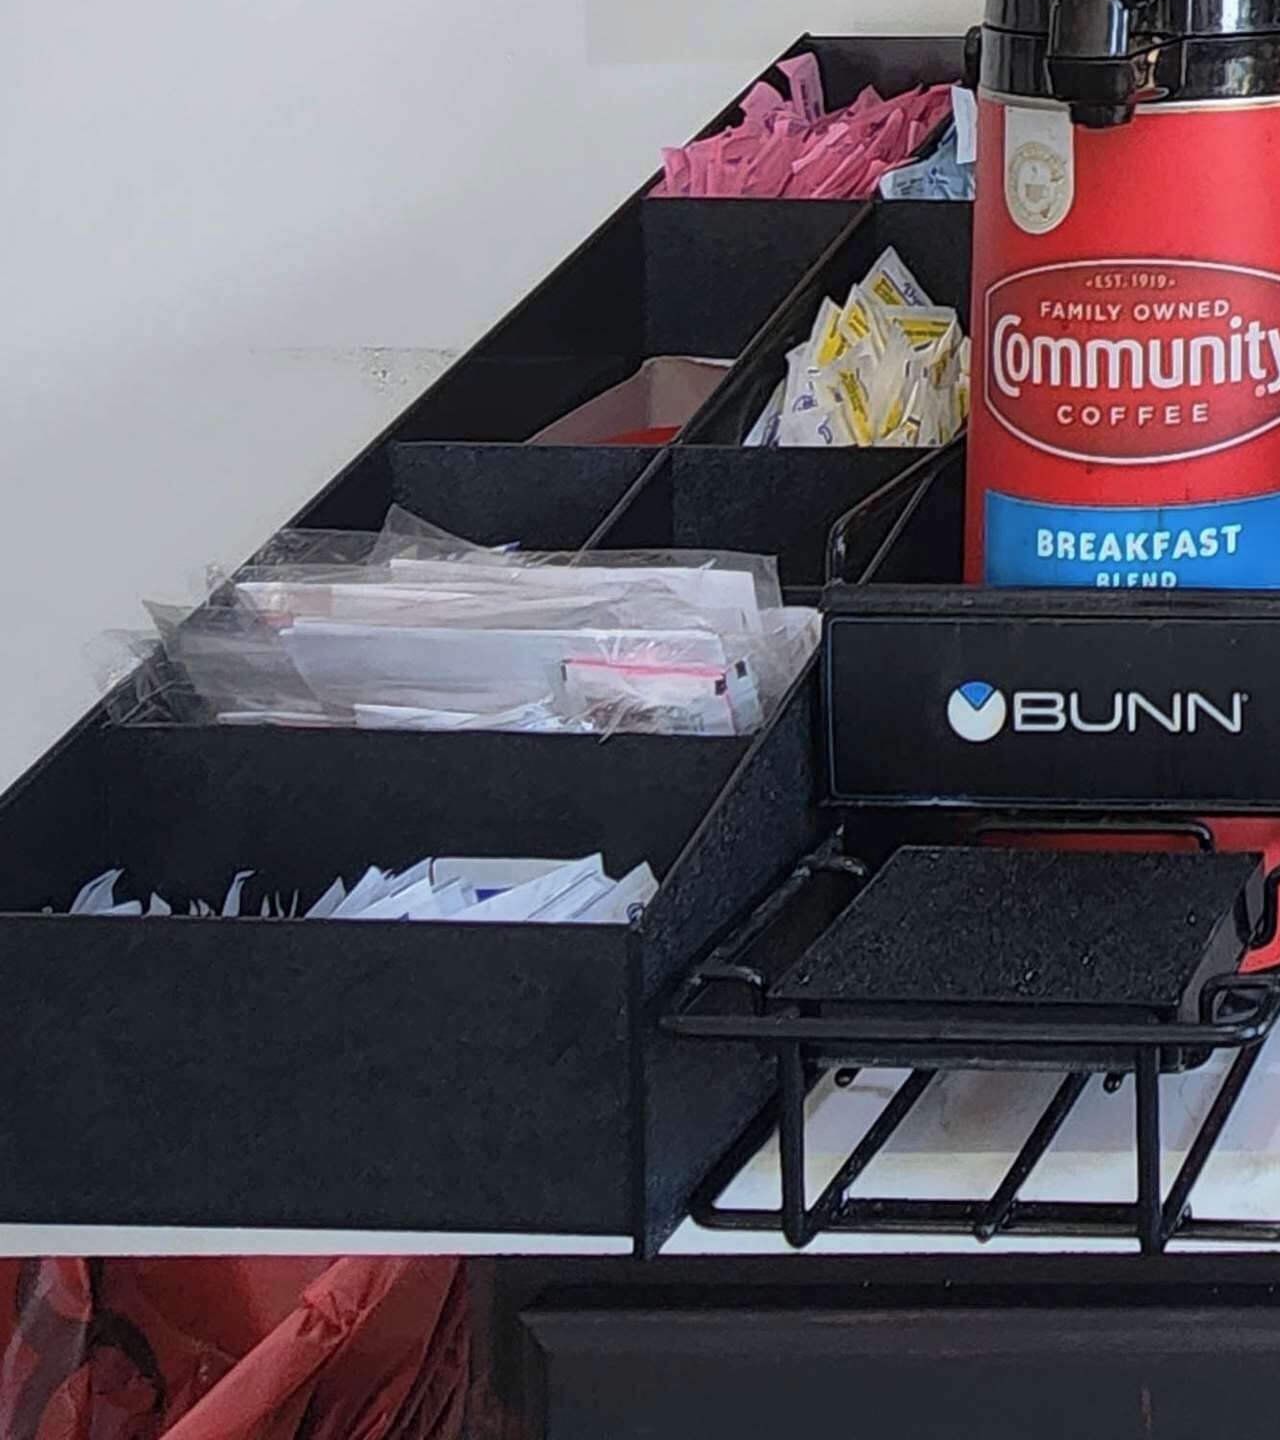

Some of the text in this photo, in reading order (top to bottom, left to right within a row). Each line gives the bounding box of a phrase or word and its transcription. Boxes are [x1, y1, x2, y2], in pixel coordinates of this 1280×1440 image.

[1040, 299, 1231, 320] FAMILY OWNED
[1057, 404, 1210, 426] COFFEE
[1037, 524, 1243, 562] BREAKFAST
[1014, 692, 1243, 734] BUNN
